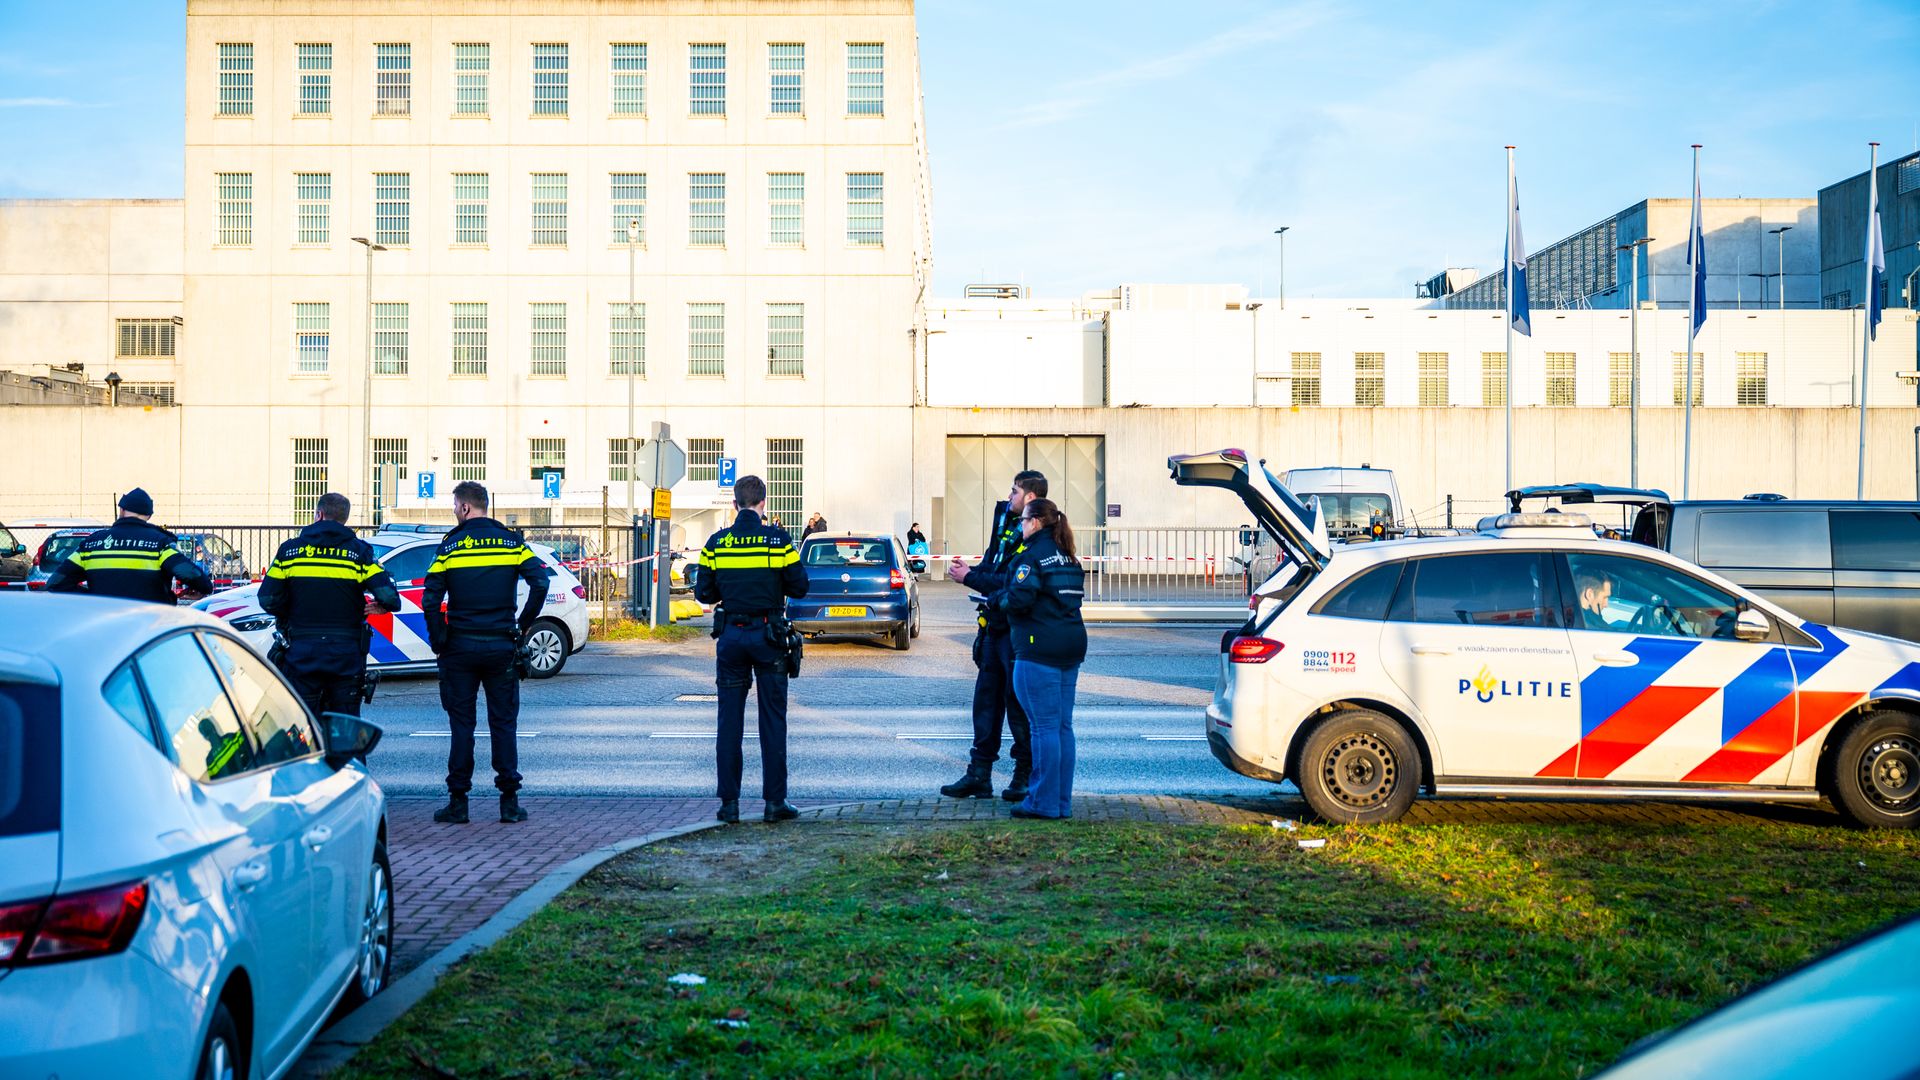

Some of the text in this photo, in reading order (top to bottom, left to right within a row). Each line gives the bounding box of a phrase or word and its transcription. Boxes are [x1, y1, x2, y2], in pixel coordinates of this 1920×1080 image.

[722, 460, 733, 475] P
[421, 474, 431, 488] P
[546, 474, 557, 488] P
[97, 538, 145, 549] POLITIE
[457, 538, 503, 549] POLITIE
[719, 535, 763, 548] POLITIE
[298, 547, 348, 557] POLITIE
[1464, 645, 1508, 653] waakzaam
[1521, 646, 1563, 654] dienstbaar
[1331, 652, 1355, 664] 112
[1331, 666, 1356, 674] spoed
[1459, 678, 1571, 703] POLITIE
